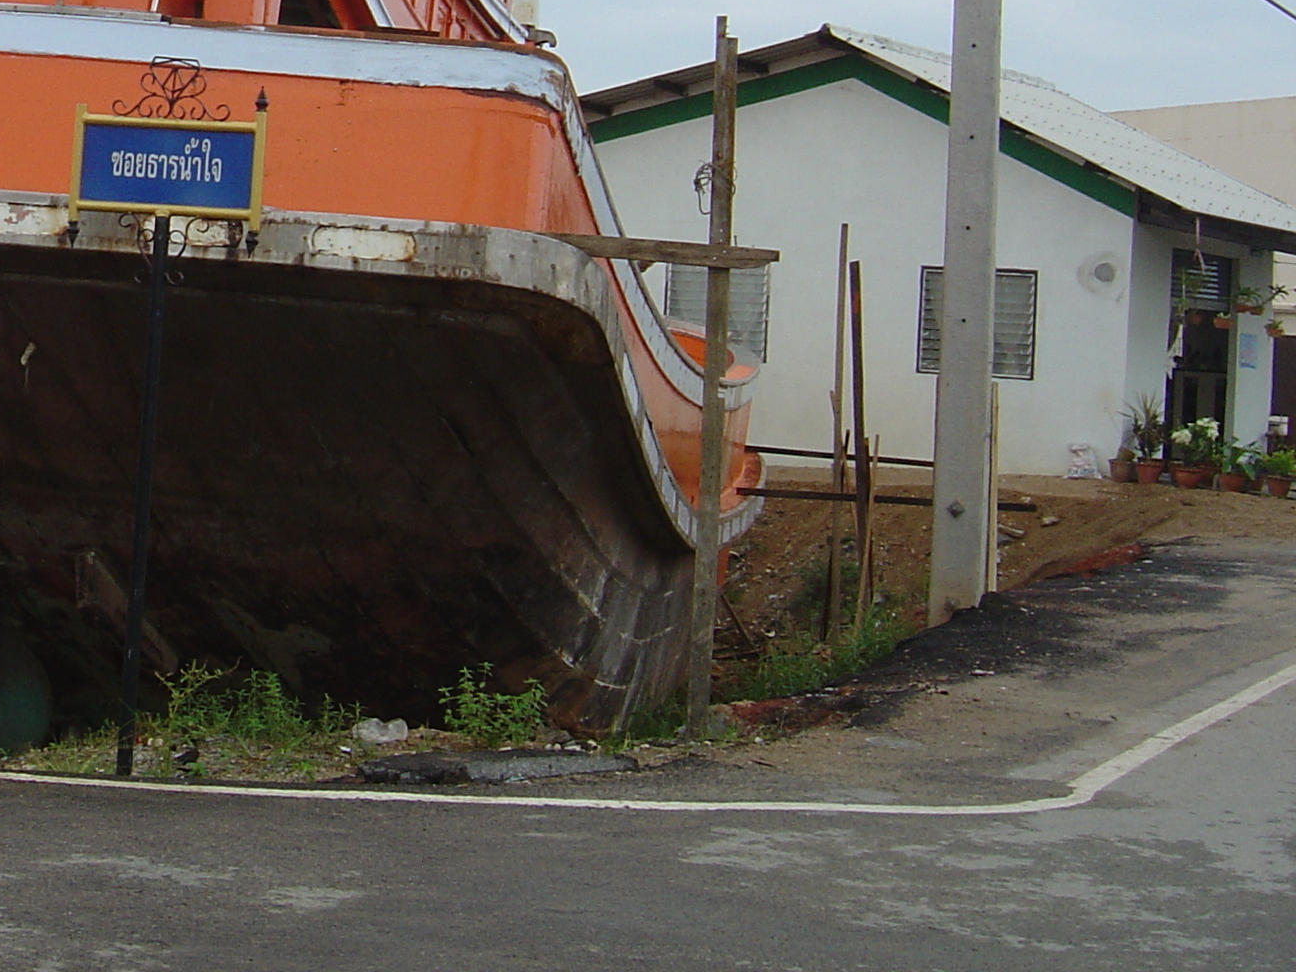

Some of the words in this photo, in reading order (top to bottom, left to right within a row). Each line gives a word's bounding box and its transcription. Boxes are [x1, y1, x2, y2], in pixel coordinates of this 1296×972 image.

[111, 137, 222, 182] ซอยธารน้ำใจ
